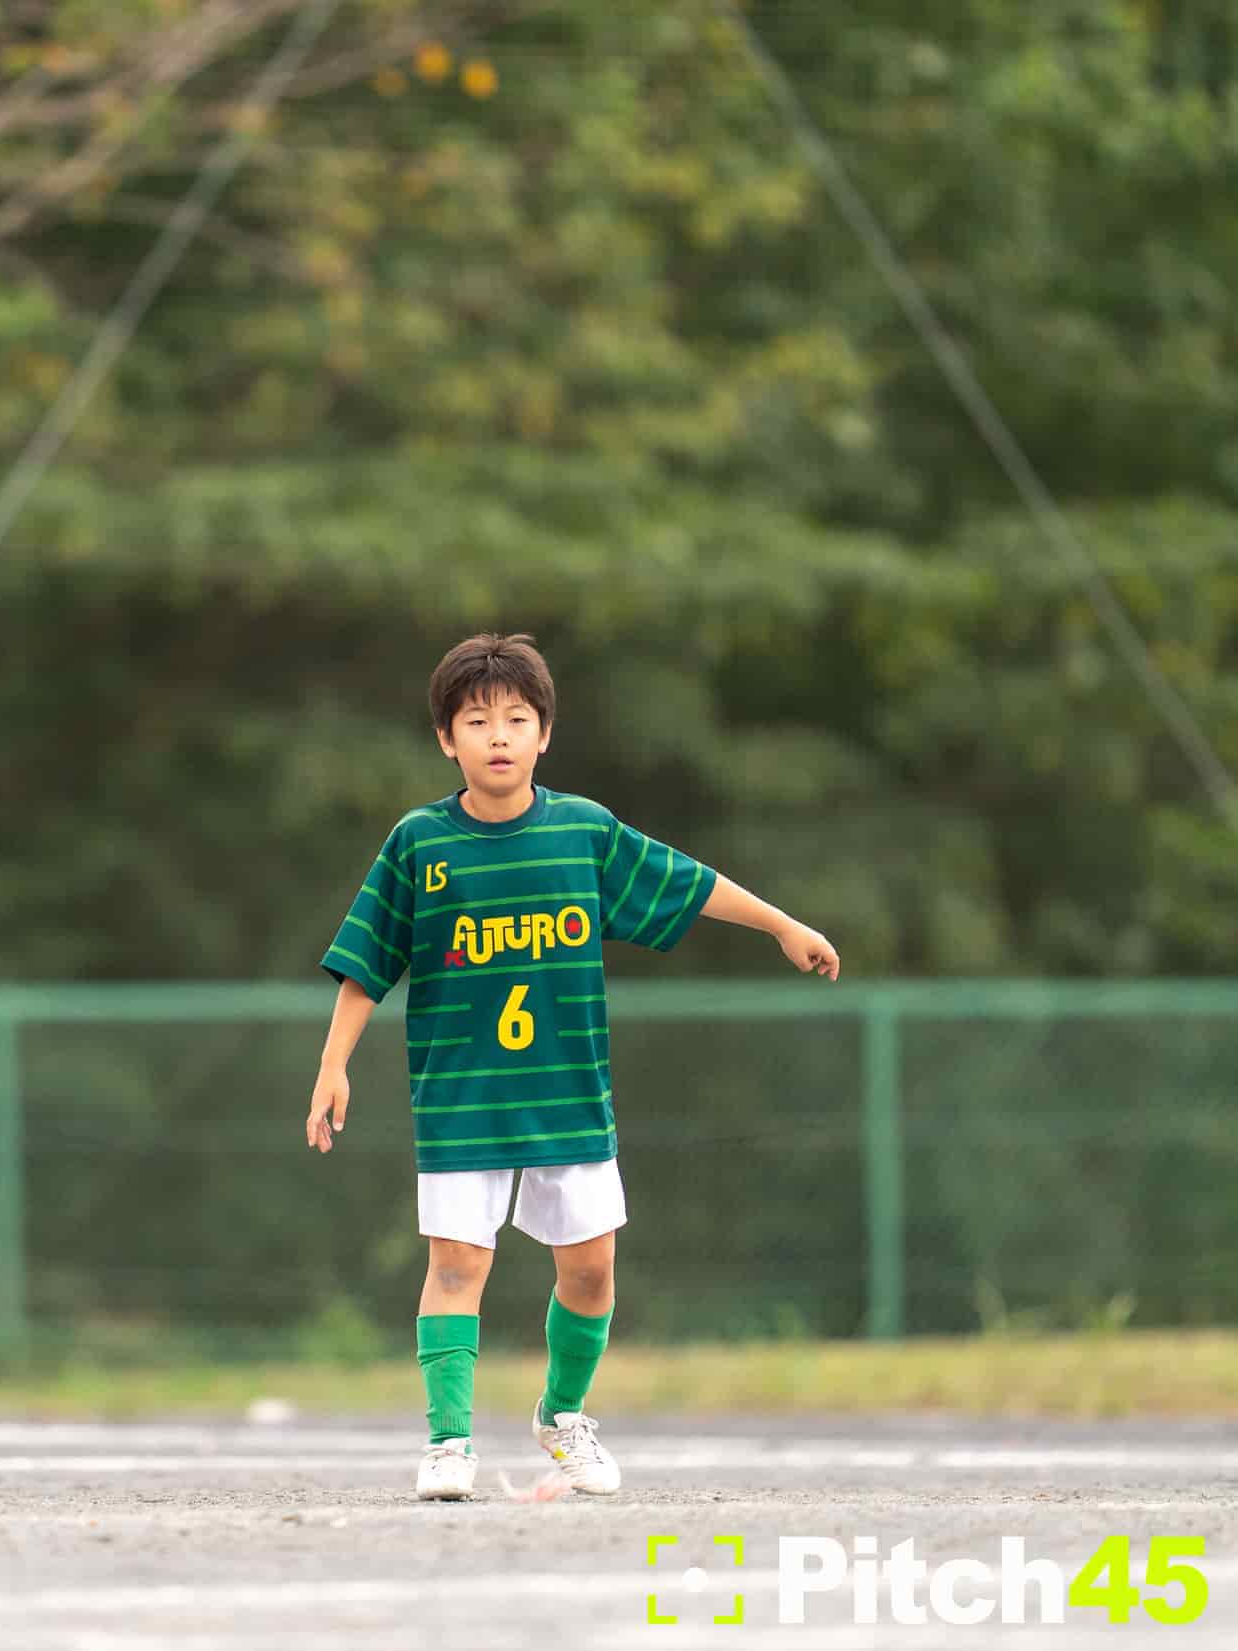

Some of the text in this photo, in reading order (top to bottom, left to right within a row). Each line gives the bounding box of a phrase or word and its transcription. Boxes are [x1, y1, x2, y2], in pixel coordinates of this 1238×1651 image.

[425, 861, 448, 893] LS
[452, 905, 591, 965] FUTURO
[497, 984, 535, 1050] 6
